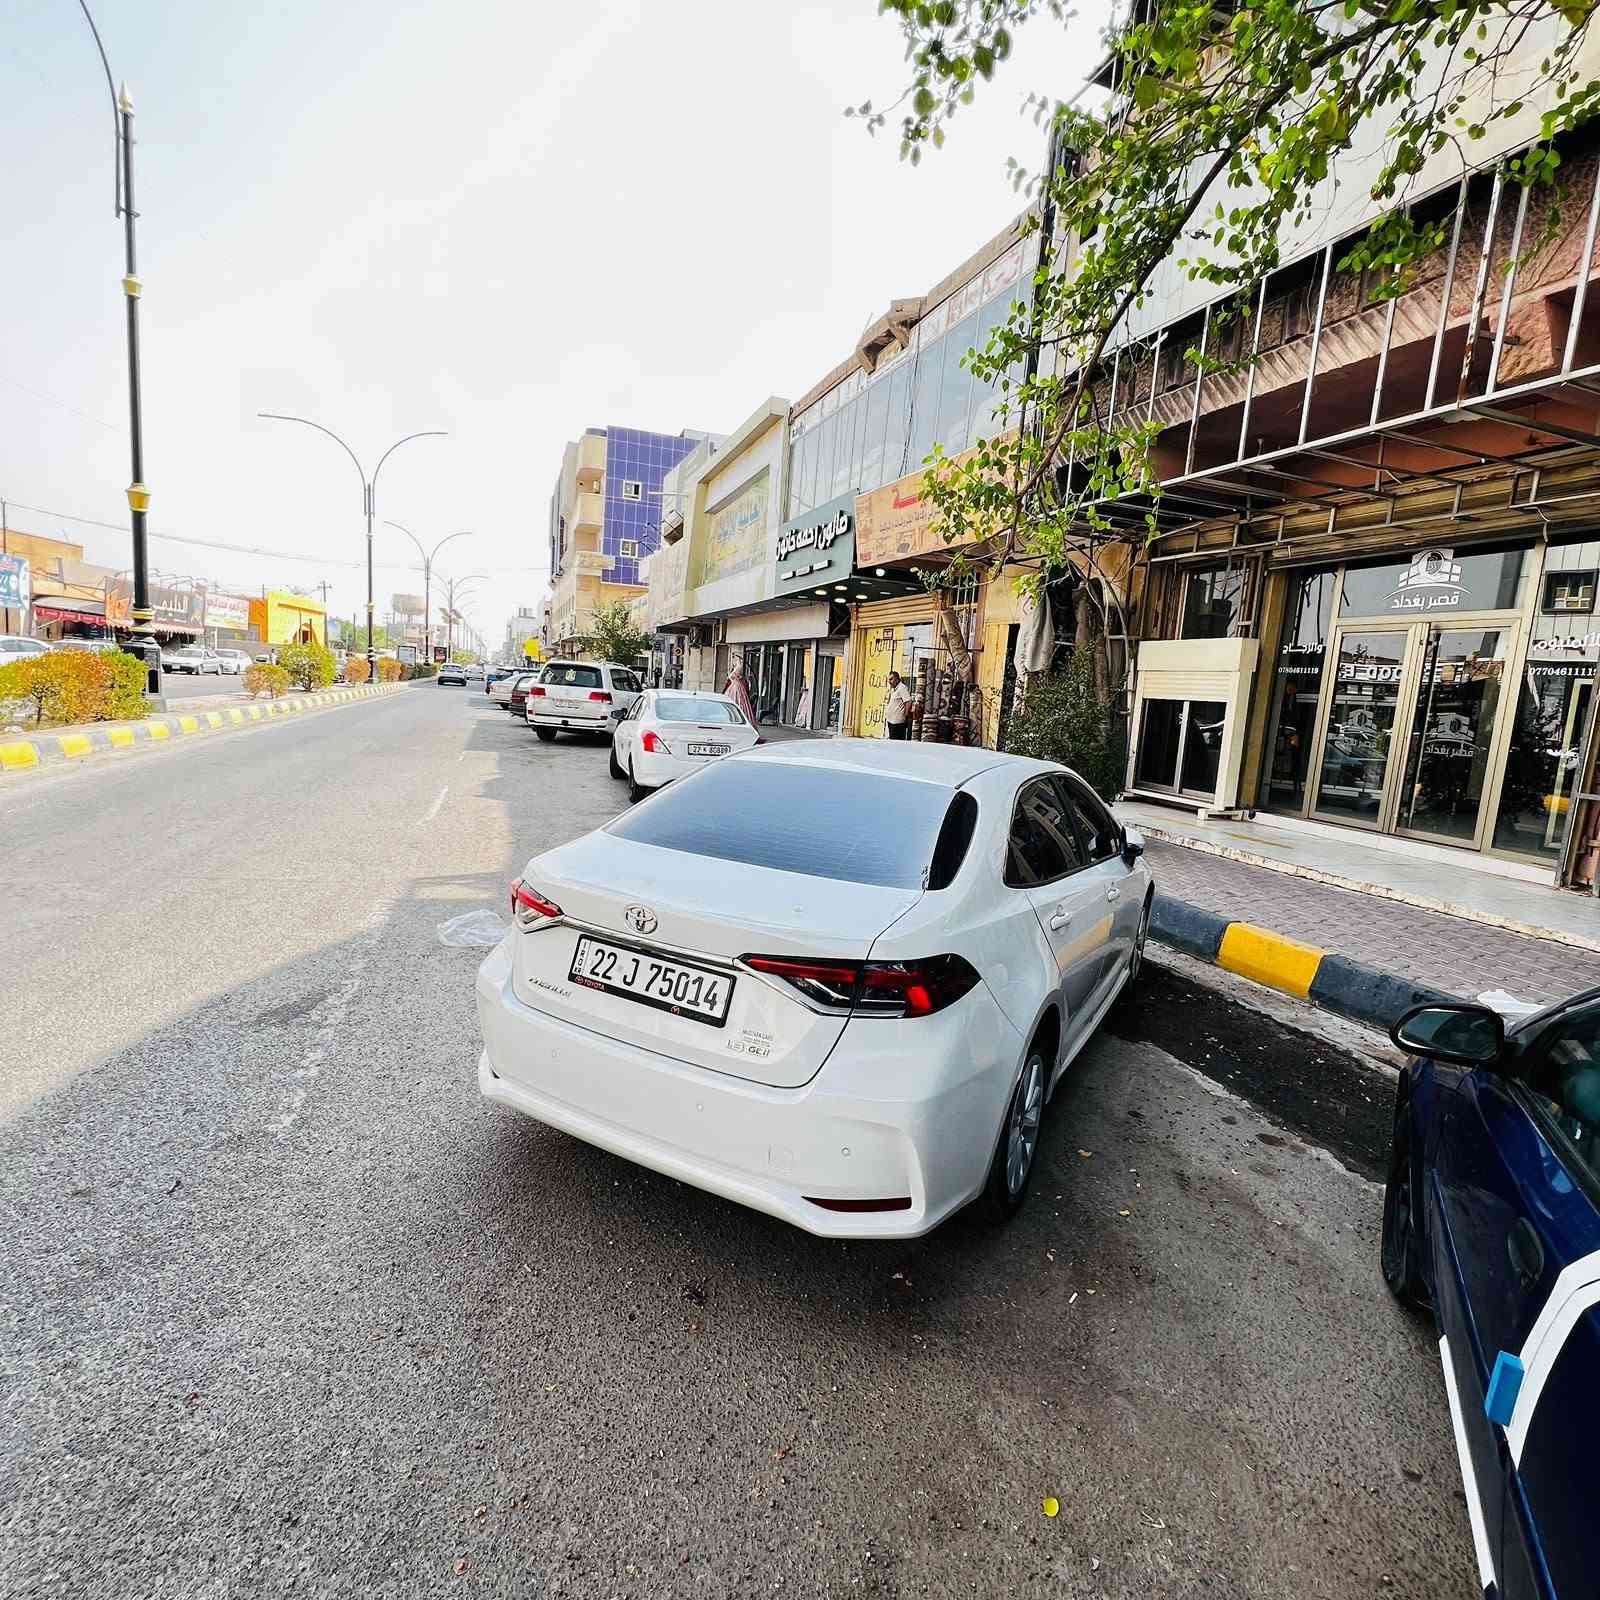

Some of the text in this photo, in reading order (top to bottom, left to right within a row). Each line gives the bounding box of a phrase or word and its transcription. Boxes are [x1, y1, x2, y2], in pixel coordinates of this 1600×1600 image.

[818, 511, 848, 549] صالون
[1391, 591, 1461, 610] قصر بغداد
[583, 979, 606, 991] TOYOTA
[589, 948, 718, 1011] 22 J 75014
